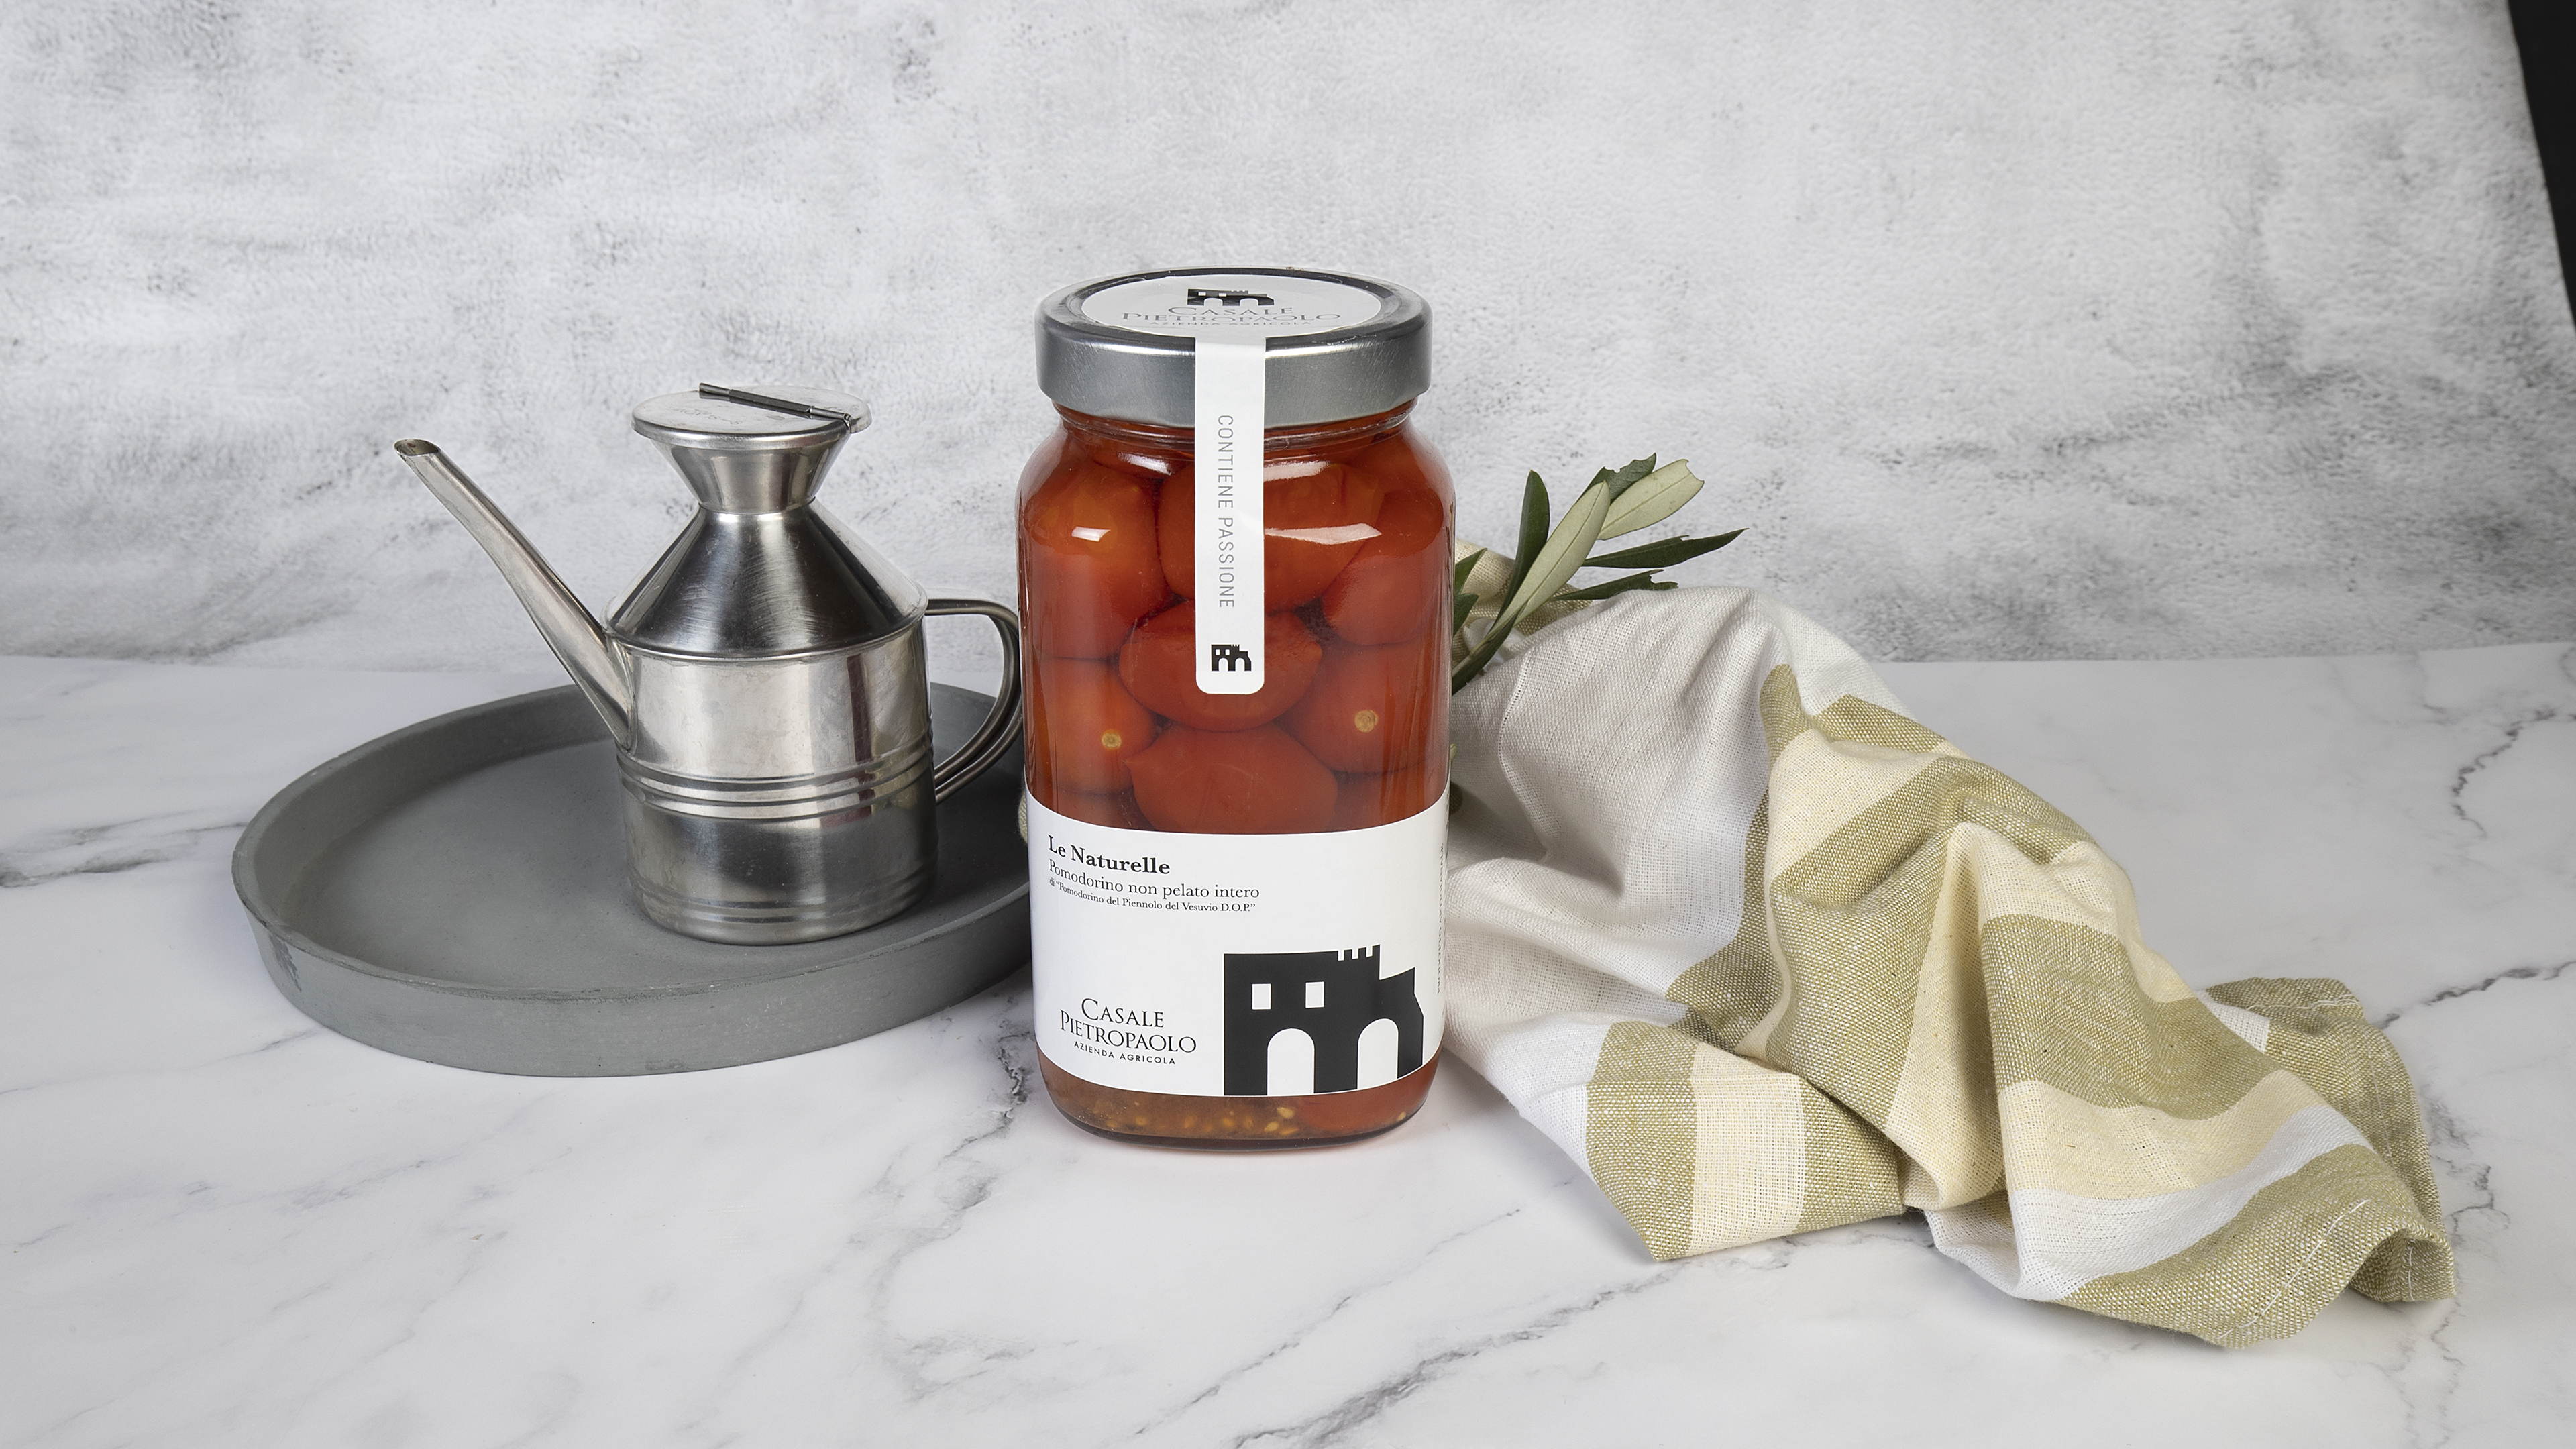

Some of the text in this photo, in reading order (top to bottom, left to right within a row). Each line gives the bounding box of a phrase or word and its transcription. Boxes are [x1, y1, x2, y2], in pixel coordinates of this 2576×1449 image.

[1122, 312, 1341, 322] PIETROPAOLO
[1168, 307, 1293, 315] CASALE
[1218, 415, 1235, 608] CONTIENE PASSIONE
[1048, 834, 1171, 875] Le Naturelle
[1049, 858, 1260, 900] Pomodorino non pelato intero
[1049, 877, 1055, 887] di
[1106, 895, 1120, 906] del
[1122, 898, 1163, 910] Piennolo
[1165, 901, 1179, 911] del
[1182, 902, 1218, 912] Vesuvio
[1059, 1008, 1197, 1053] PIETROPAOLO
[1081, 998, 1164, 1028] CASALE
[1074, 1040, 1176, 1065] AZIENDA AGRICOLA
